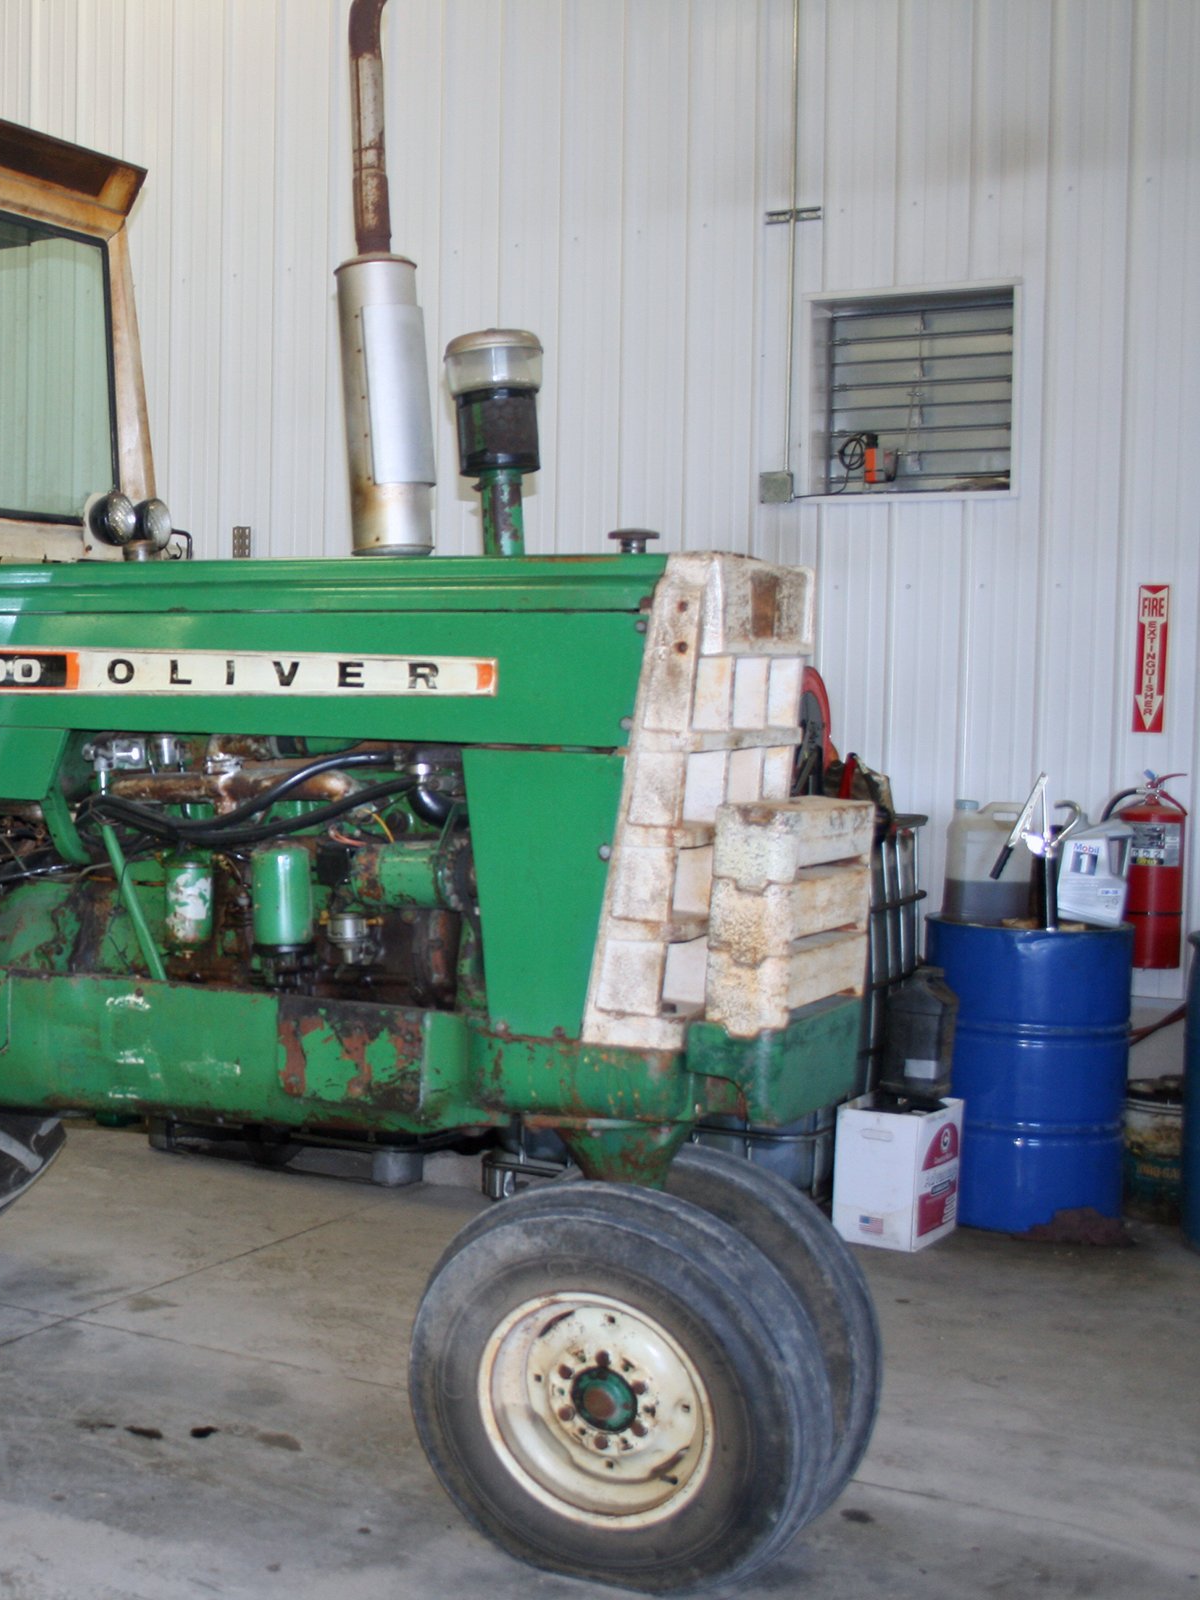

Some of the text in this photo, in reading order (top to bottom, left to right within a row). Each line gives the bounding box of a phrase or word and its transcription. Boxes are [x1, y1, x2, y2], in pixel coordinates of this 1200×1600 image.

[1142, 598, 1164, 617] FIRE
[107, 658, 439, 690] OLIVER
[1143, 621, 1157, 715] EXTINGUISHER
[1073, 843, 1100, 854] Mobil
[1080, 853, 1088, 873] 1
